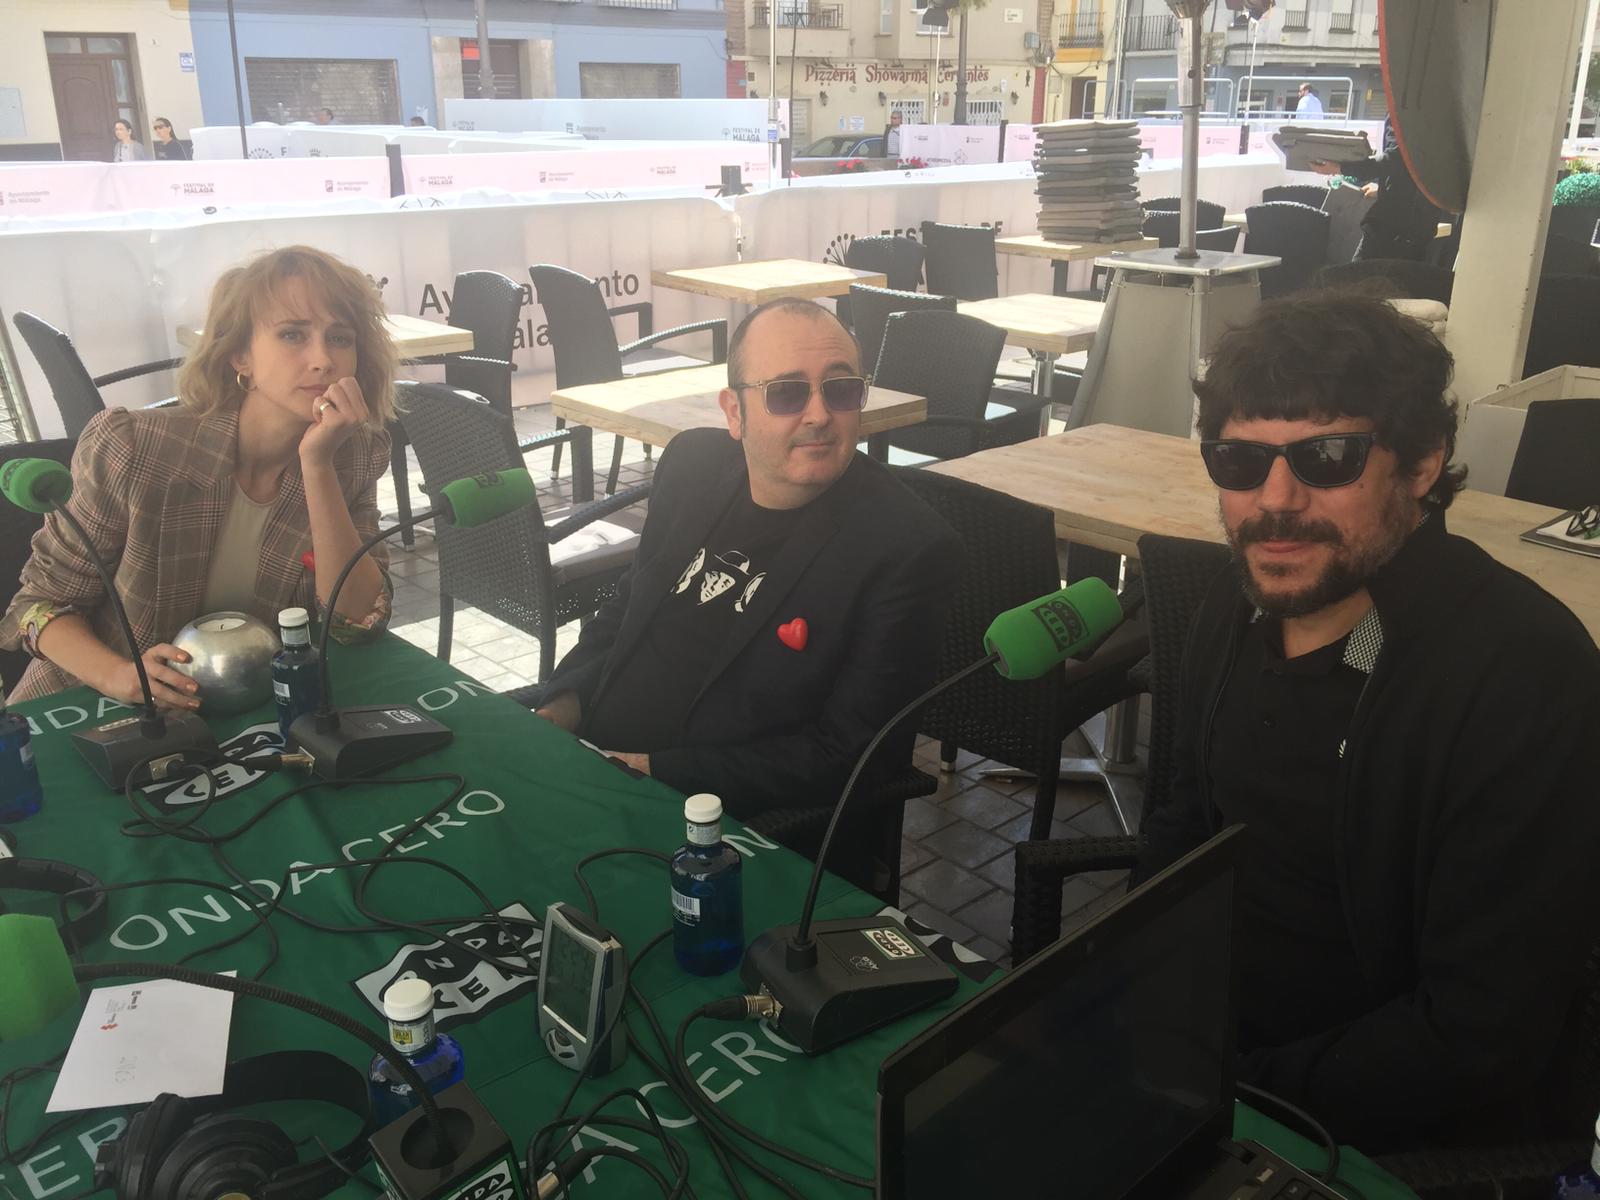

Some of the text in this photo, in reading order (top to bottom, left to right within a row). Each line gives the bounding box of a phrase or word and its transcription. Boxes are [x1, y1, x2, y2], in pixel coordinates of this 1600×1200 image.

[805, 64, 990, 87] Pizzeria Showarma Cerntes
[109, 790, 506, 953] ONDA CERO
